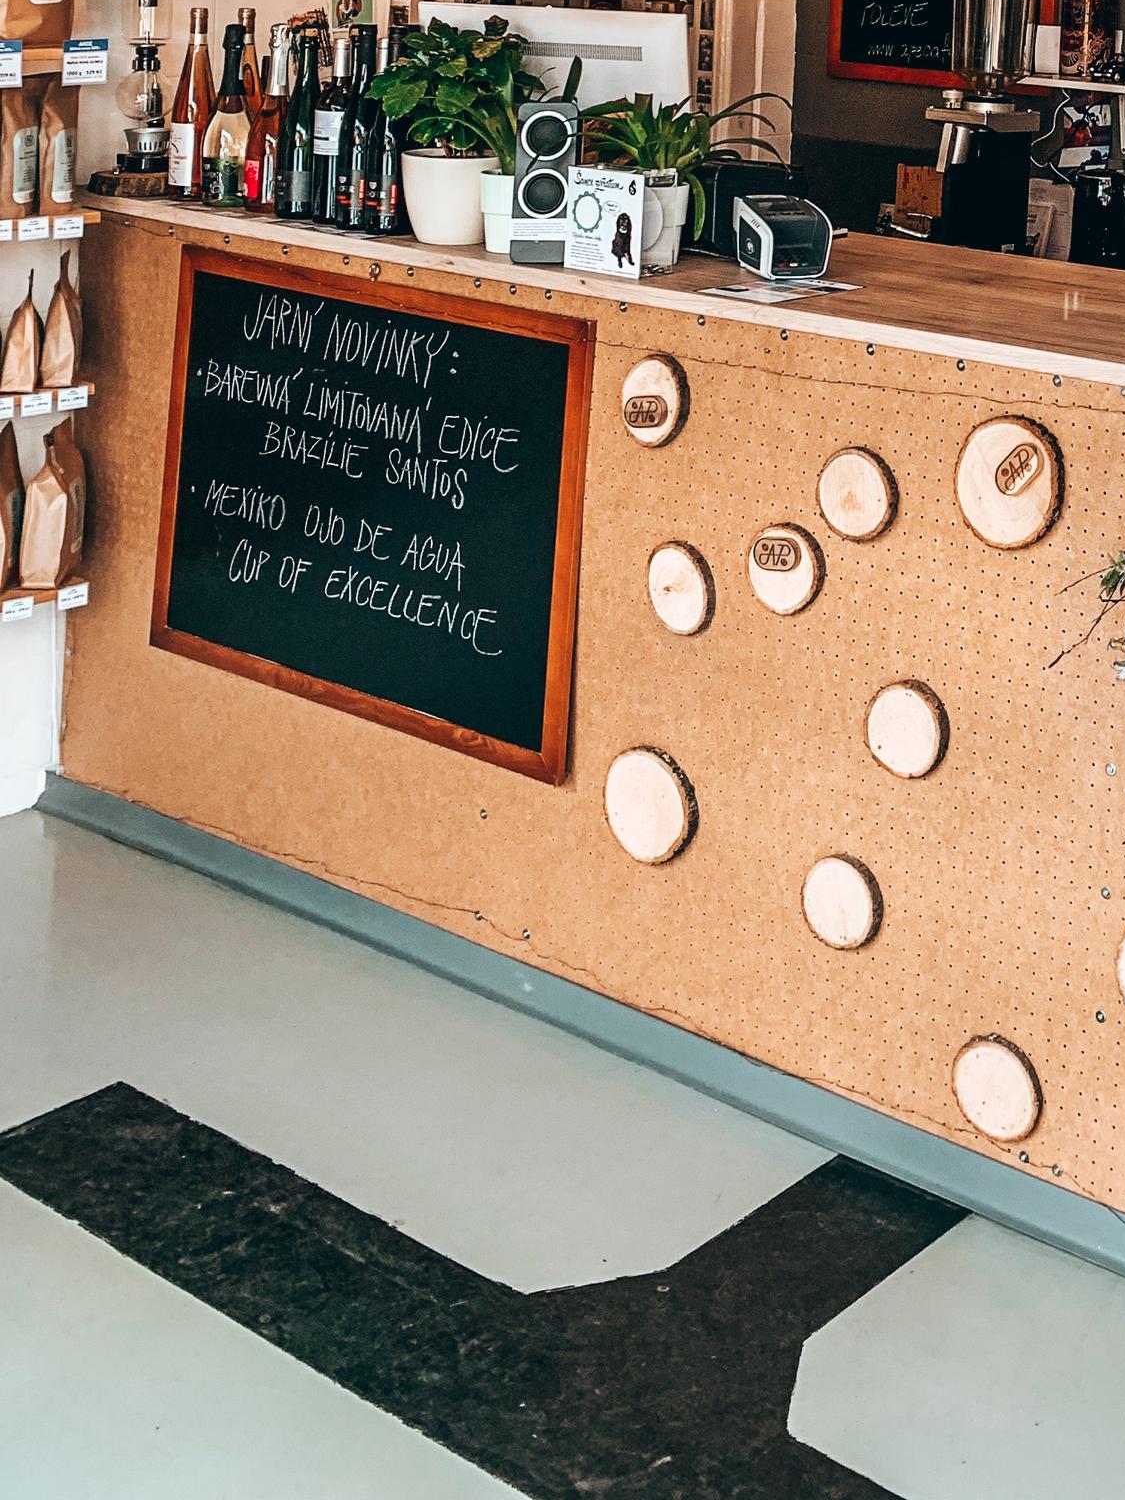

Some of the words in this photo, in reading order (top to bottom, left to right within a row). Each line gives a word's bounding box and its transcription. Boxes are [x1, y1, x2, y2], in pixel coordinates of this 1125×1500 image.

[243, 293, 324, 353] JARNÍ
[204, 358, 304, 415] BAREVNÁ
[303, 378, 433, 455] LIMITOVANÁ
[438, 414, 521, 474] EDICE
[259, 421, 370, 480] BRAZÍLIE
[385, 448, 468, 510] SANTOS
[204, 479, 287, 532] MEXIKO
[304, 504, 346, 546] OJO
[353, 518, 393, 560] DE
[400, 534, 466, 592] AGUA
[228, 538, 271, 584] CUP
[278, 555, 313, 594] OF
[323, 565, 503, 656] EXCELLENCE
